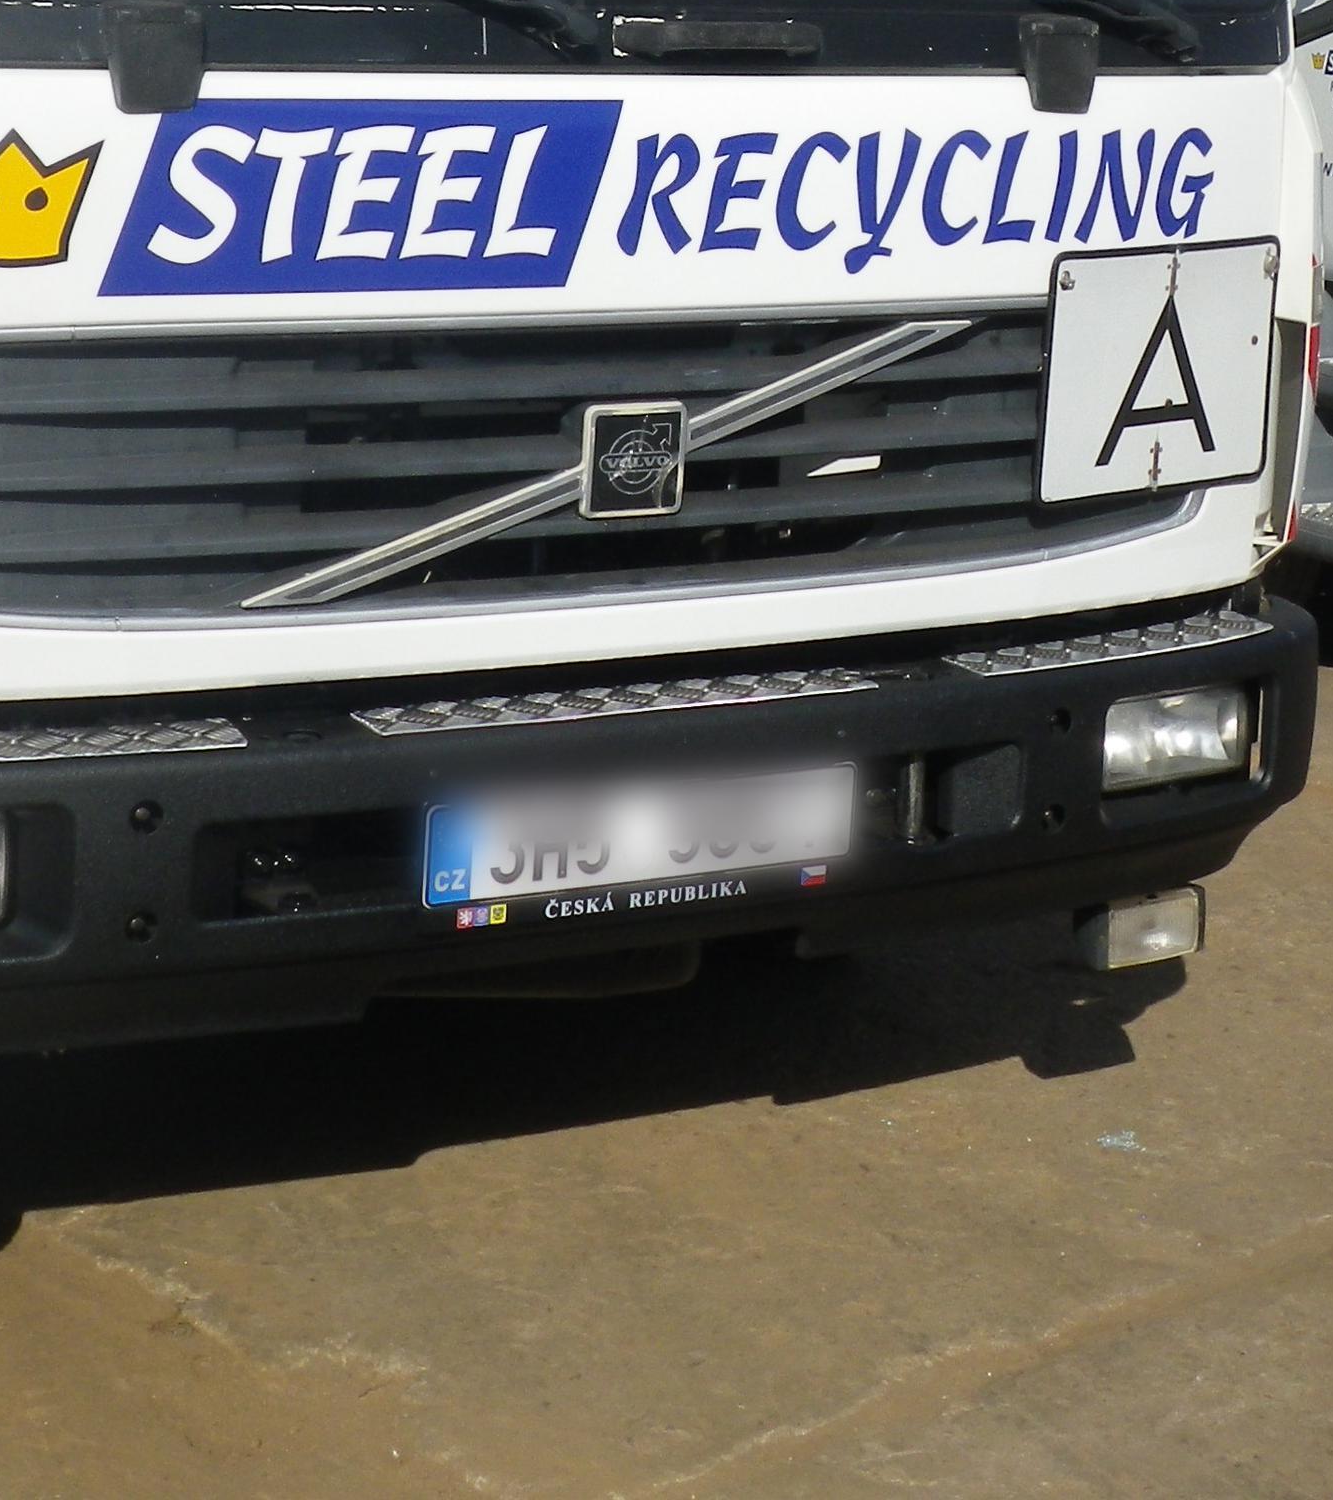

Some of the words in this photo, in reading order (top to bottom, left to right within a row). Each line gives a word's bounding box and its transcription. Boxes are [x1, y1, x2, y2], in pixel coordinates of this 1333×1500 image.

[147, 124, 558, 264] STEEL
[619, 127, 1214, 274] RECYCLING
[1095, 294, 1216, 467] A
[605, 455, 669, 470] VOLVO
[434, 868, 467, 892] CZ
[544, 890, 615, 920] ČESKÁ
[629, 878, 748, 909] REPUBLIKA
